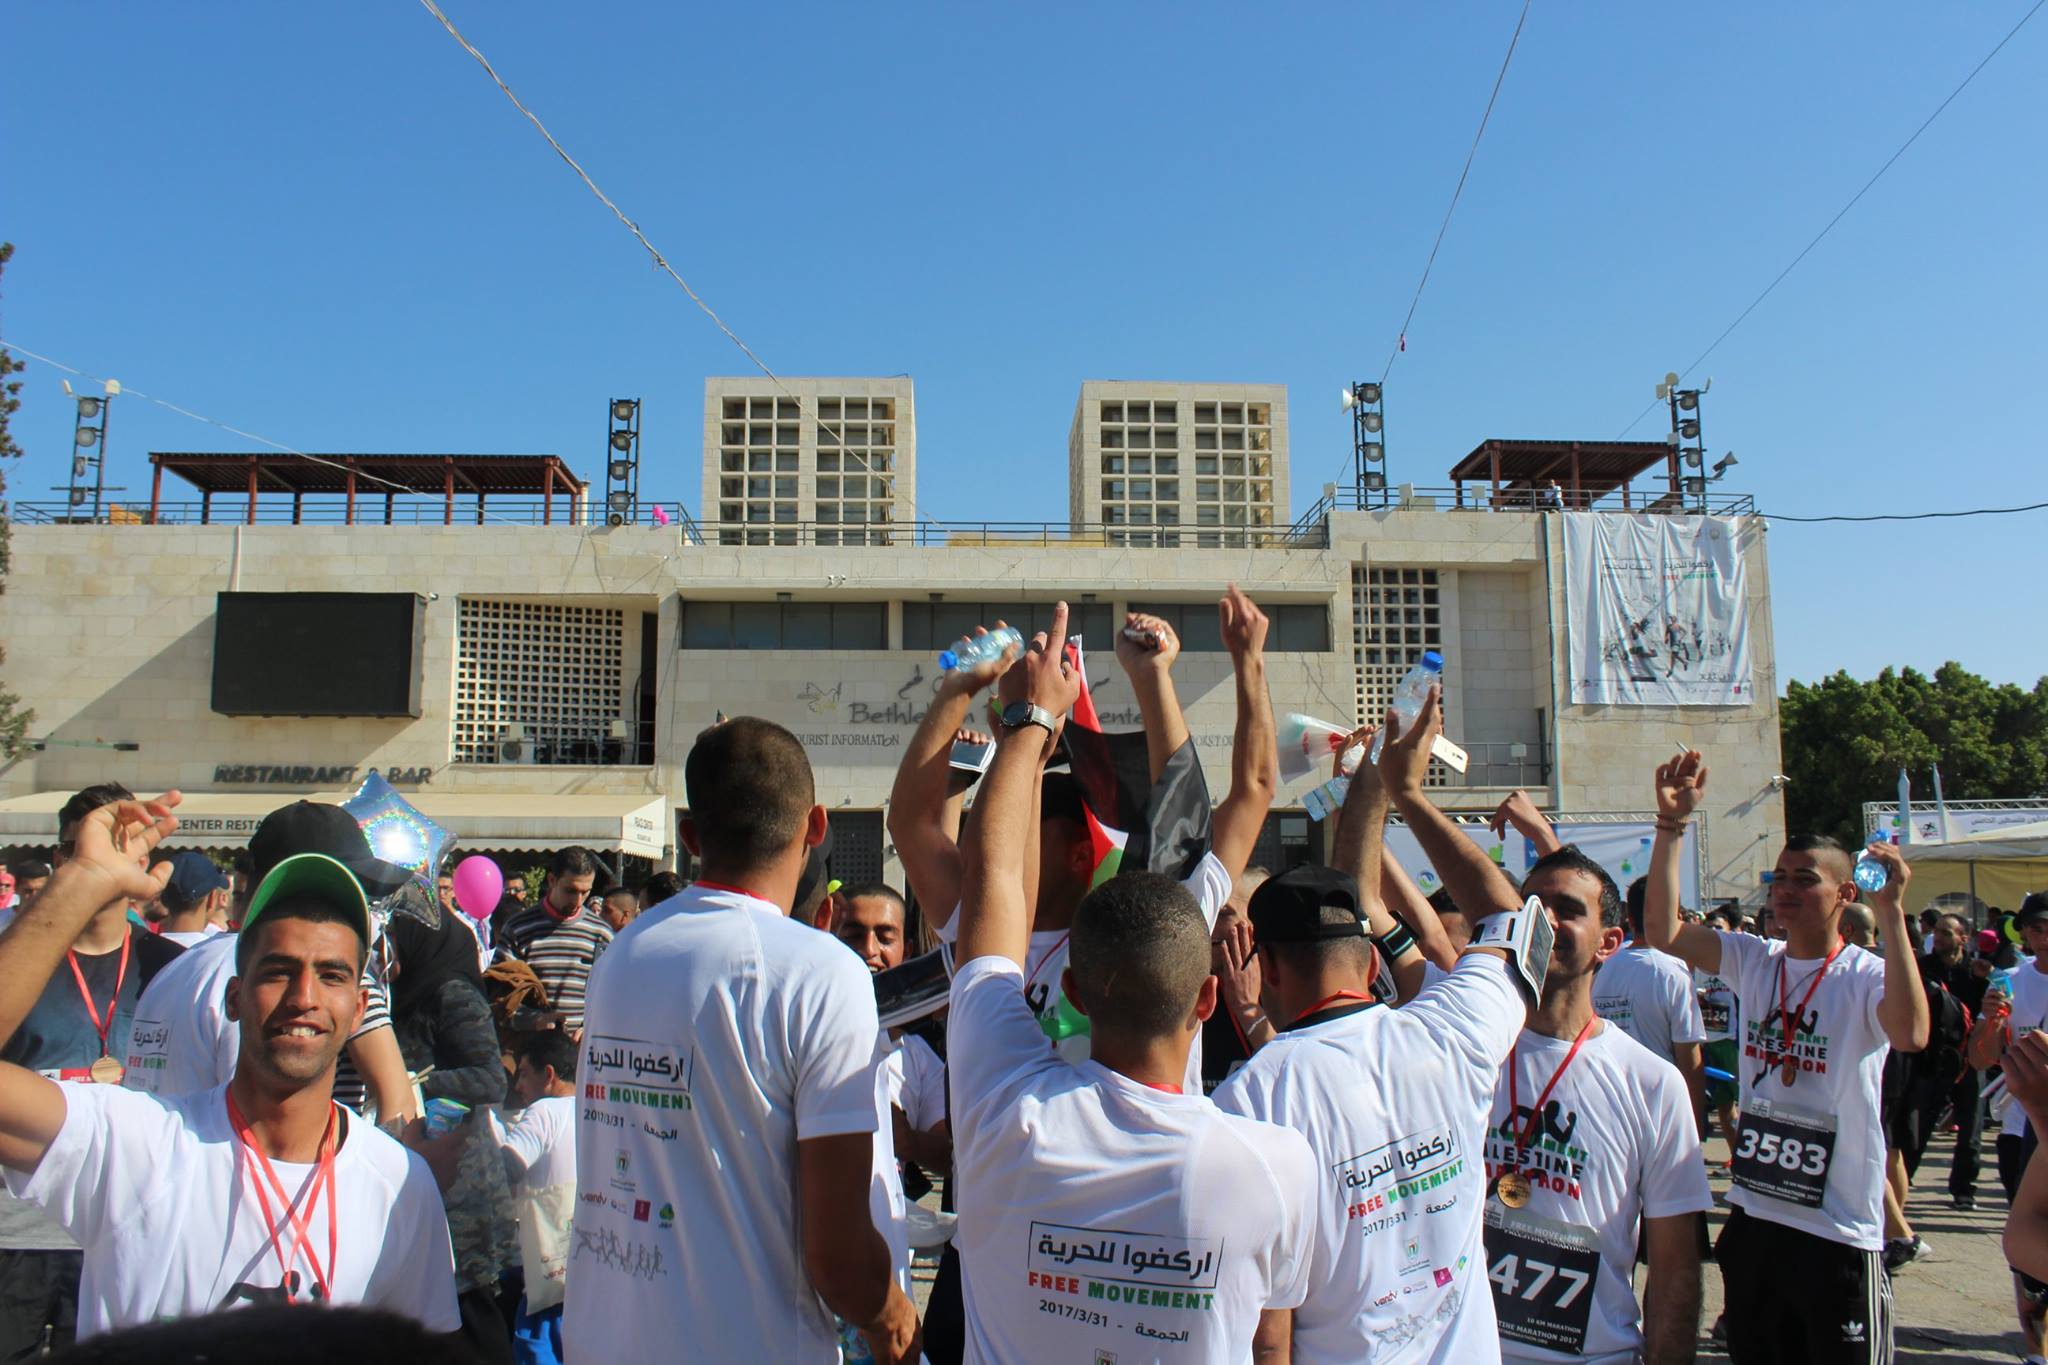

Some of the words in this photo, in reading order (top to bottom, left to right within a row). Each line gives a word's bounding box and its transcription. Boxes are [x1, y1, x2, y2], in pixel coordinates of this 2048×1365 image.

[1100, 707, 1143, 724] ente
[798, 733, 829, 746] OURIST
[831, 733, 900, 747] INFORMATION
[213, 764, 359, 784] RESTAURANT
[387, 766, 433, 785] BAR
[226, 819, 262, 831] RESTA
[628, 1049, 685, 1082] اركضوا
[609, 1086, 693, 1111] MOVEMENT
[643, 1121, 678, 1141] الجمعة
[1397, 1129, 1455, 1170] اركضوا
[1483, 1142, 1584, 1181] ALESTINE
[1736, 1128, 1828, 1176] 3583
[1345, 1153, 1394, 1190] للحرية
[1347, 1195, 1384, 1220] FREE
[1037, 1234, 1117, 1265] للحرية
[1122, 1243, 1213, 1280] اركضوا
[1028, 1271, 1080, 1294] FREE
[1087, 1281, 1215, 1310] MOVEMENT
[1487, 1252, 1590, 1309] 477
[1039, 1299, 1109, 1328] 2017/3/31
[1134, 1321, 1190, 1343] الجمعة
[1516, 1325, 1558, 1341] MARATHON
[1559, 1334, 1578, 1344] 2017
[1547, 1321, 1582, 1334] MARATHON
